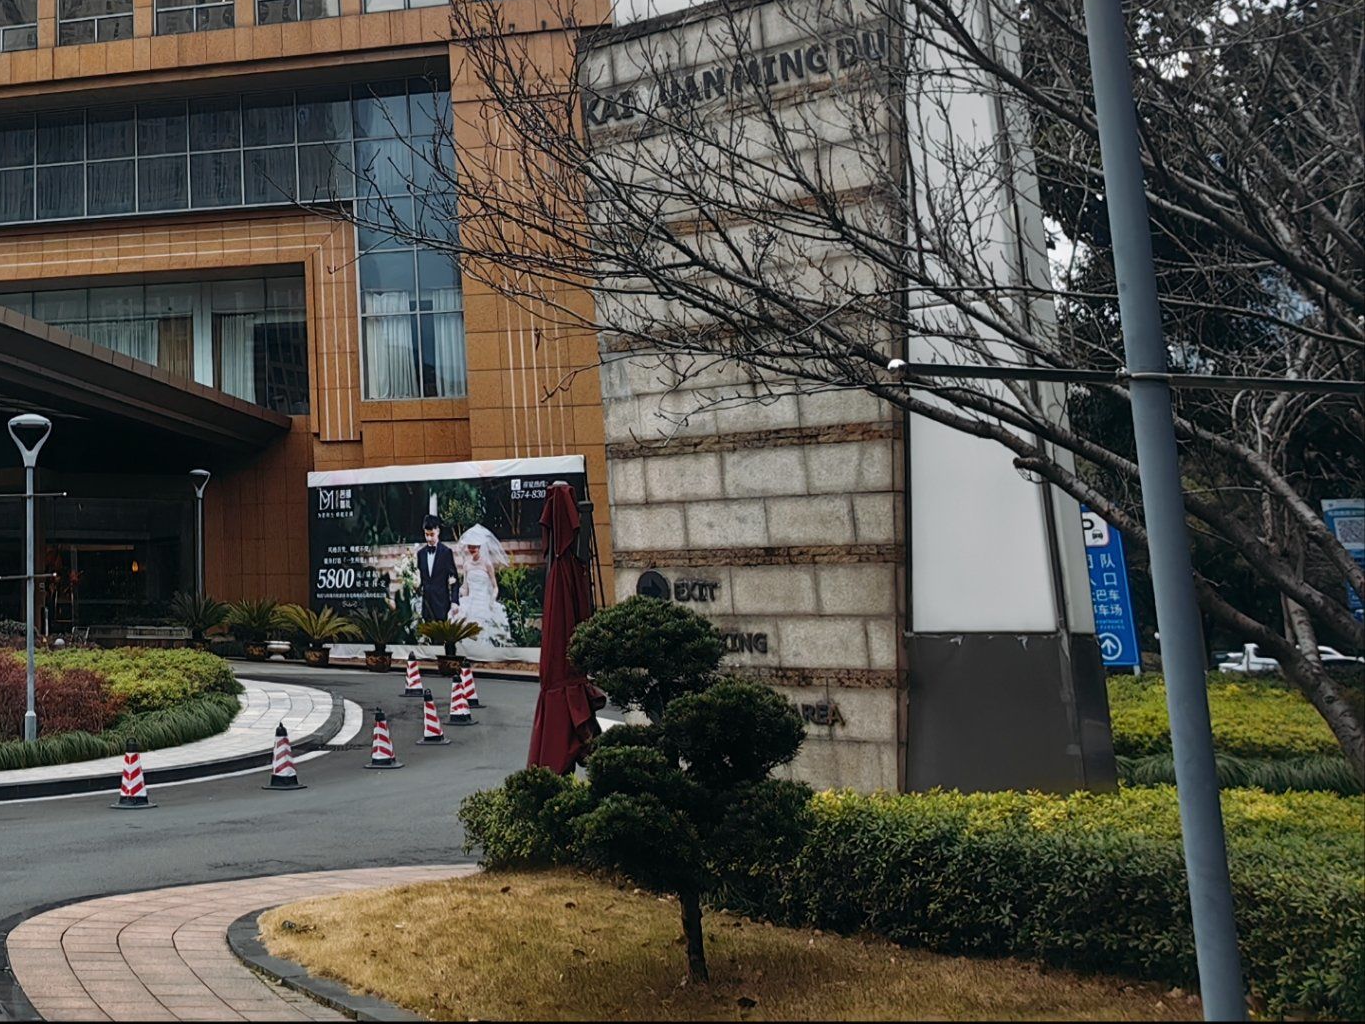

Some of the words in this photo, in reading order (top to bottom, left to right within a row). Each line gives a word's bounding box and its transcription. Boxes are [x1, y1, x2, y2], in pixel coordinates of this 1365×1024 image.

[734, 43, 829, 93] MING
[511, 489, 546, 500] 0574-830
[316, 568, 355, 589] 5800
[674, 581, 721, 603] EXIT
[1092, 588, 1121, 602] 巴车
[1094, 603, 1123, 617] 车场
